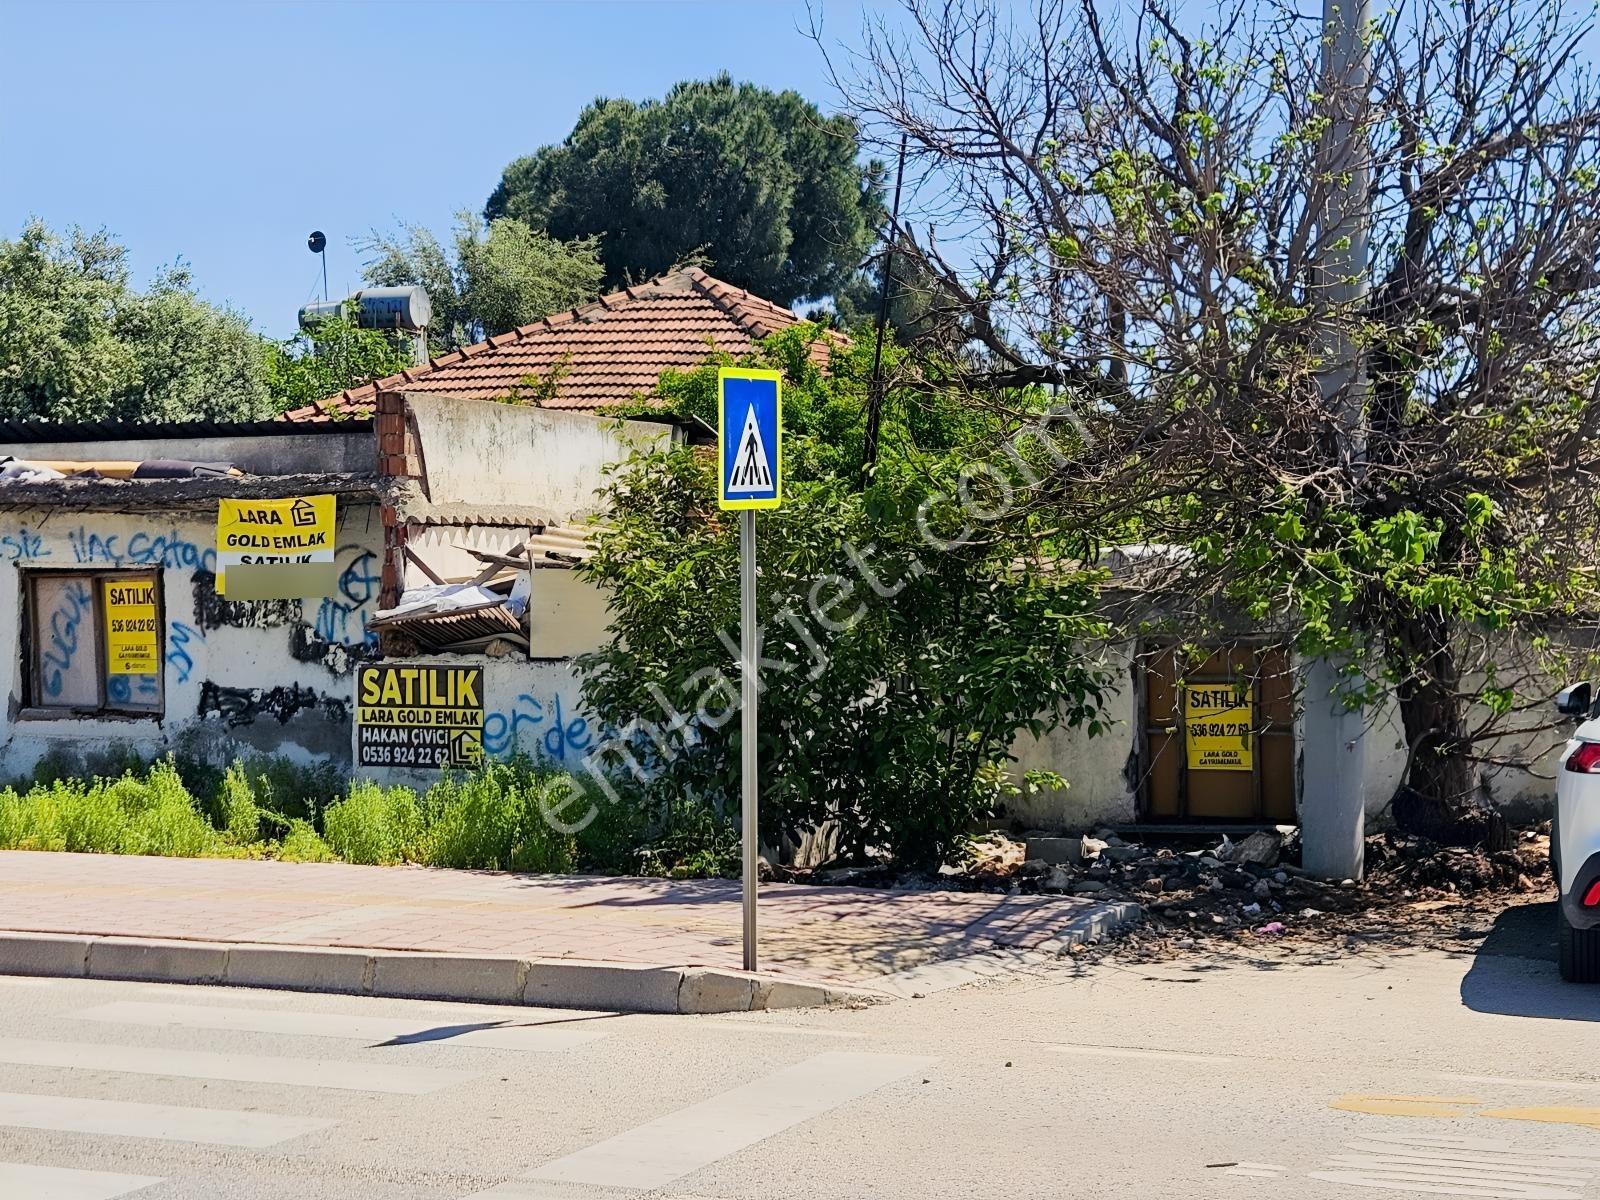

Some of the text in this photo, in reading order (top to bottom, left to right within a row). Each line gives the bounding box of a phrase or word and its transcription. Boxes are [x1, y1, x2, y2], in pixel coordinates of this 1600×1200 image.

[238, 508, 282, 525] LARA
[227, 532, 325, 549] GOLD EMLAK
[110, 587, 155, 605] SATILIK
[362, 668, 479, 706] SATILIK
[1190, 690, 1249, 708] SATILIK
[362, 709, 479, 725] LARA GOLD EMLAK
[362, 727, 408, 743] HAKAN
[1191, 723, 1207, 737] 536
[1209, 723, 1225, 737] 924
[362, 746, 449, 763] 0536 924 22 62
